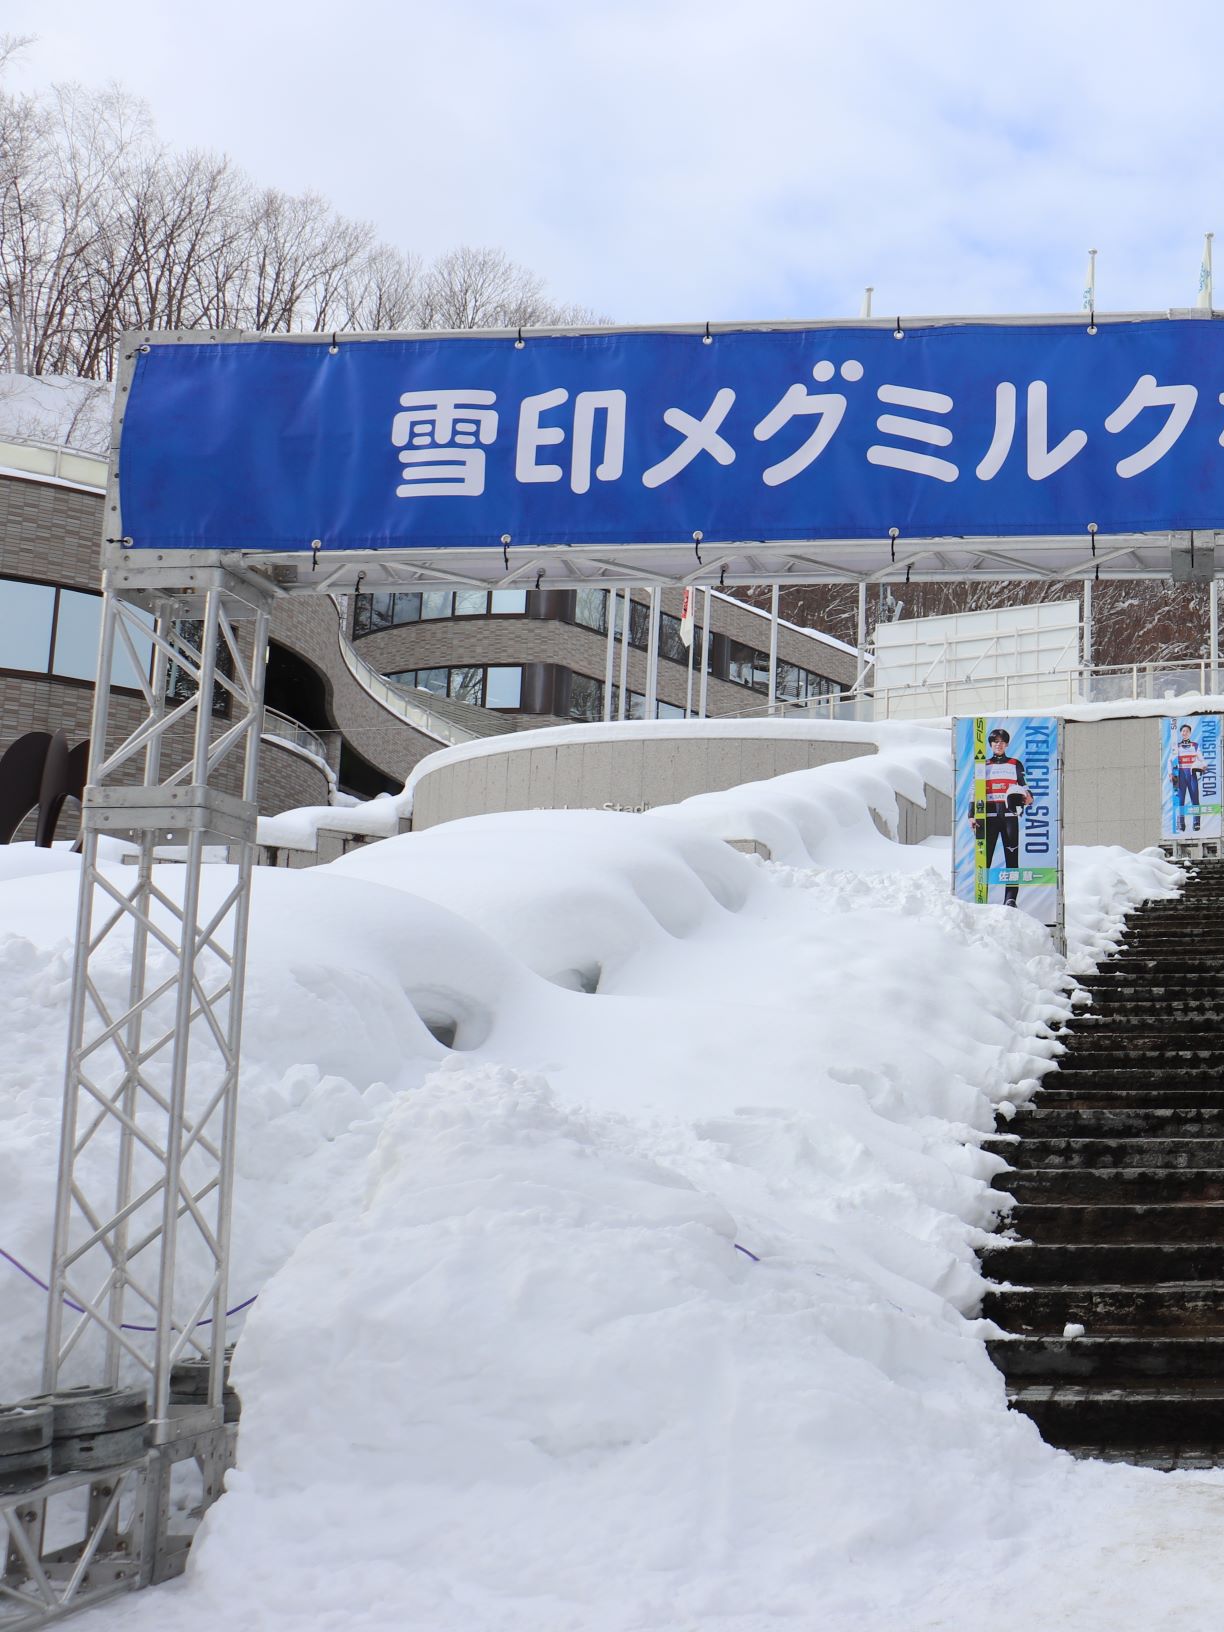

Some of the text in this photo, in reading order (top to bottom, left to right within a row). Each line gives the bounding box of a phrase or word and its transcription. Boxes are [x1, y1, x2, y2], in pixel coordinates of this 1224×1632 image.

[976, 717, 984, 743] FIS
[1202, 720, 1217, 797] RYUSEI IKEDA
[602, 801, 652, 814] Stadi
[1025, 725, 1049, 854] KEIICHI SATO
